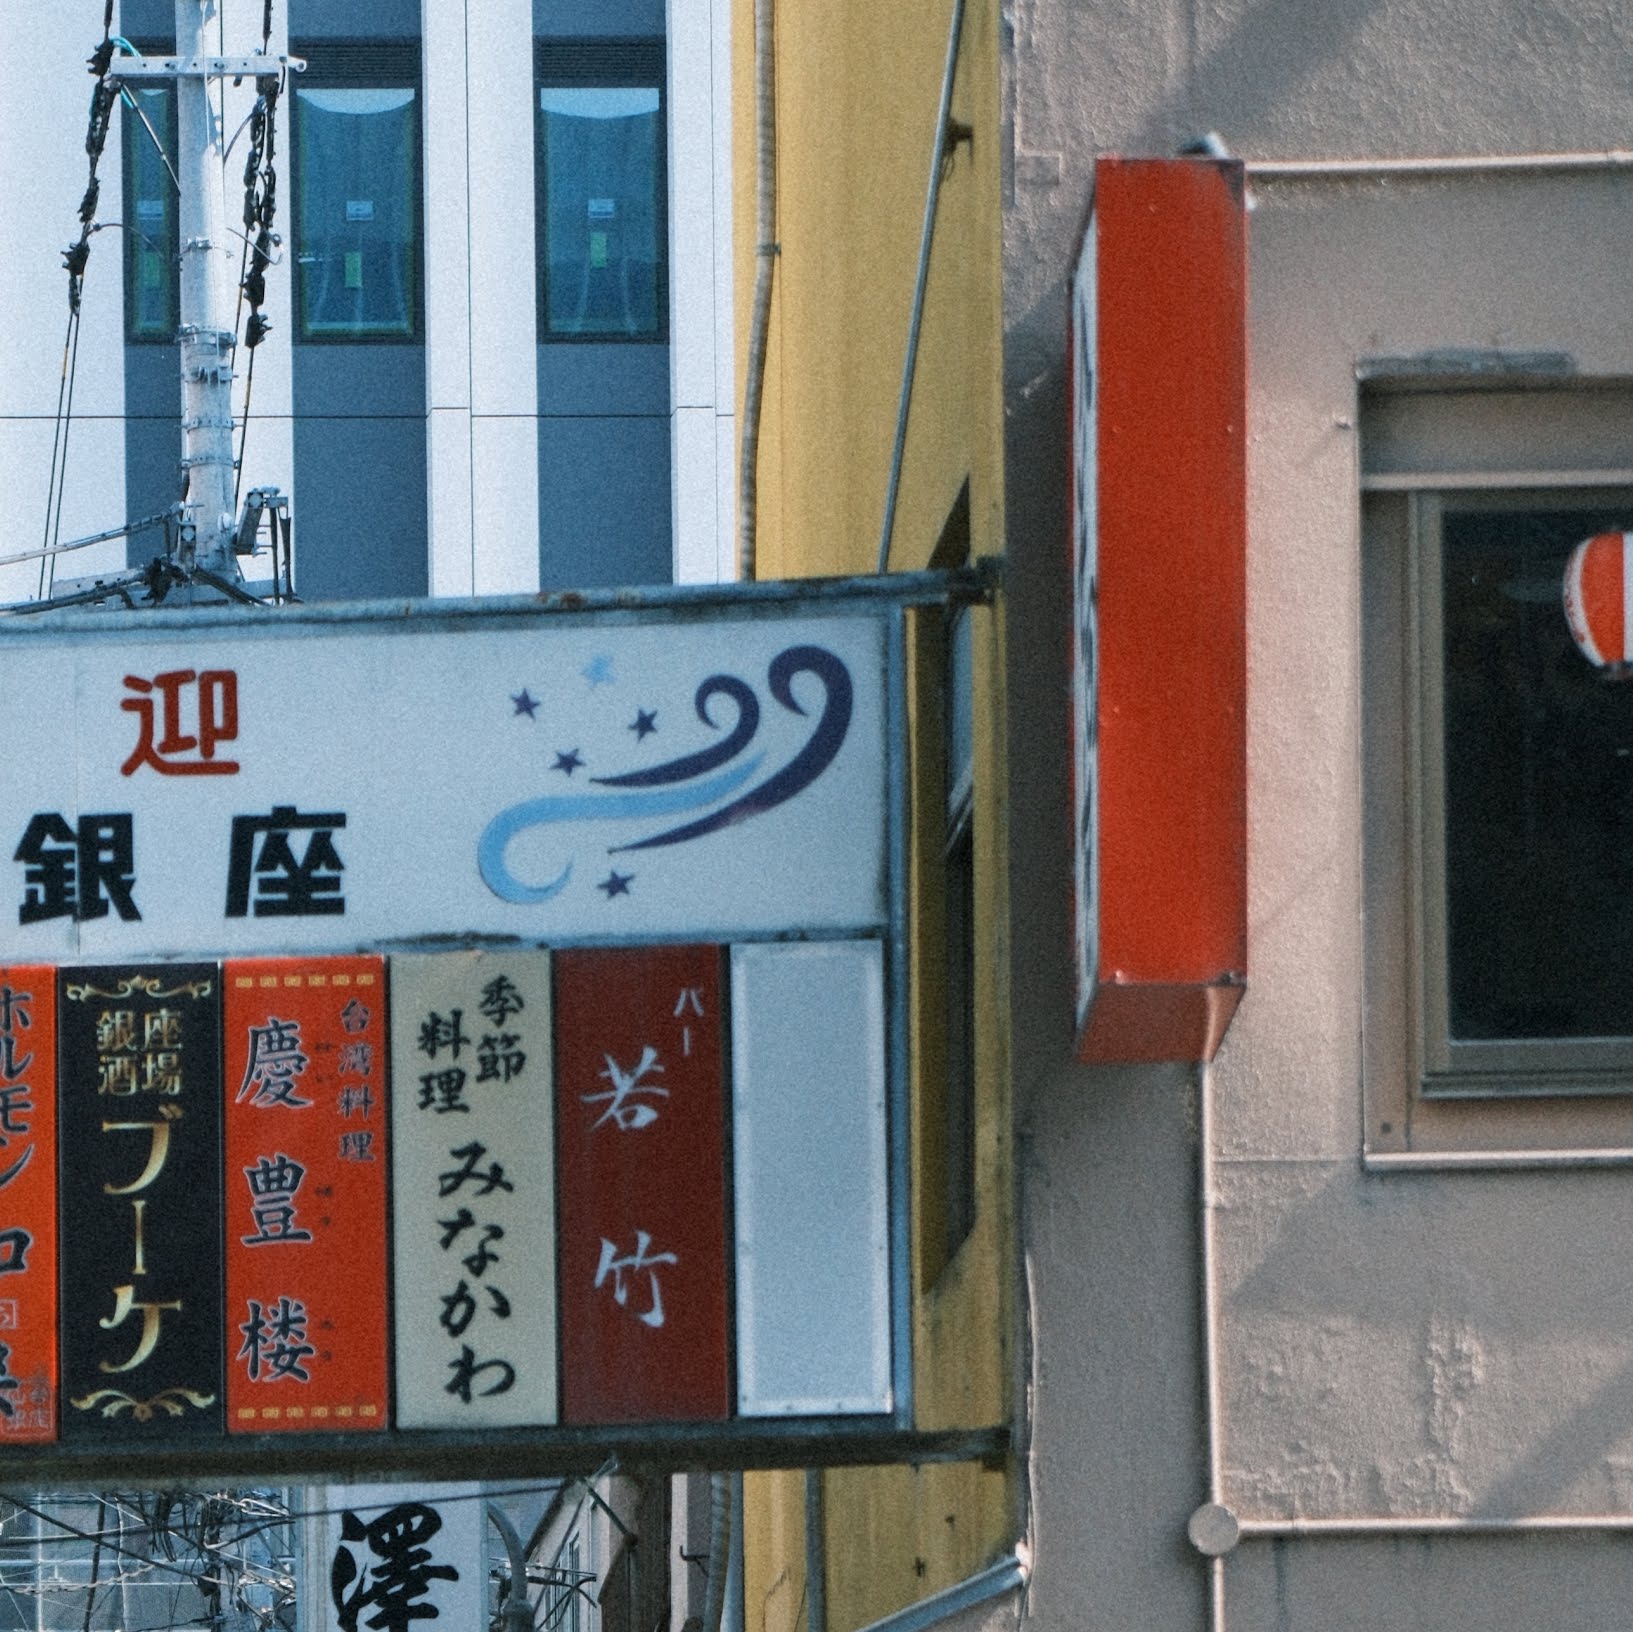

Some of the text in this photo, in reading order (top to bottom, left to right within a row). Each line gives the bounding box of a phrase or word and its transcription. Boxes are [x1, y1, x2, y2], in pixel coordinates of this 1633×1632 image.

[96, 1008, 183, 1052] 銀座
[96, 1052, 183, 1097] 酒場
[336, 998, 375, 1163] 台湾料理
[418, 1008, 470, 1115] 料理
[476, 974, 526, 1084] 季節
[98, 1103, 183, 1375] ブーケ
[235, 1015, 315, 1384] 慶豊楼
[579, 1045, 679, 1330] 若竹
[436, 1141, 518, 1405] みなかわ
